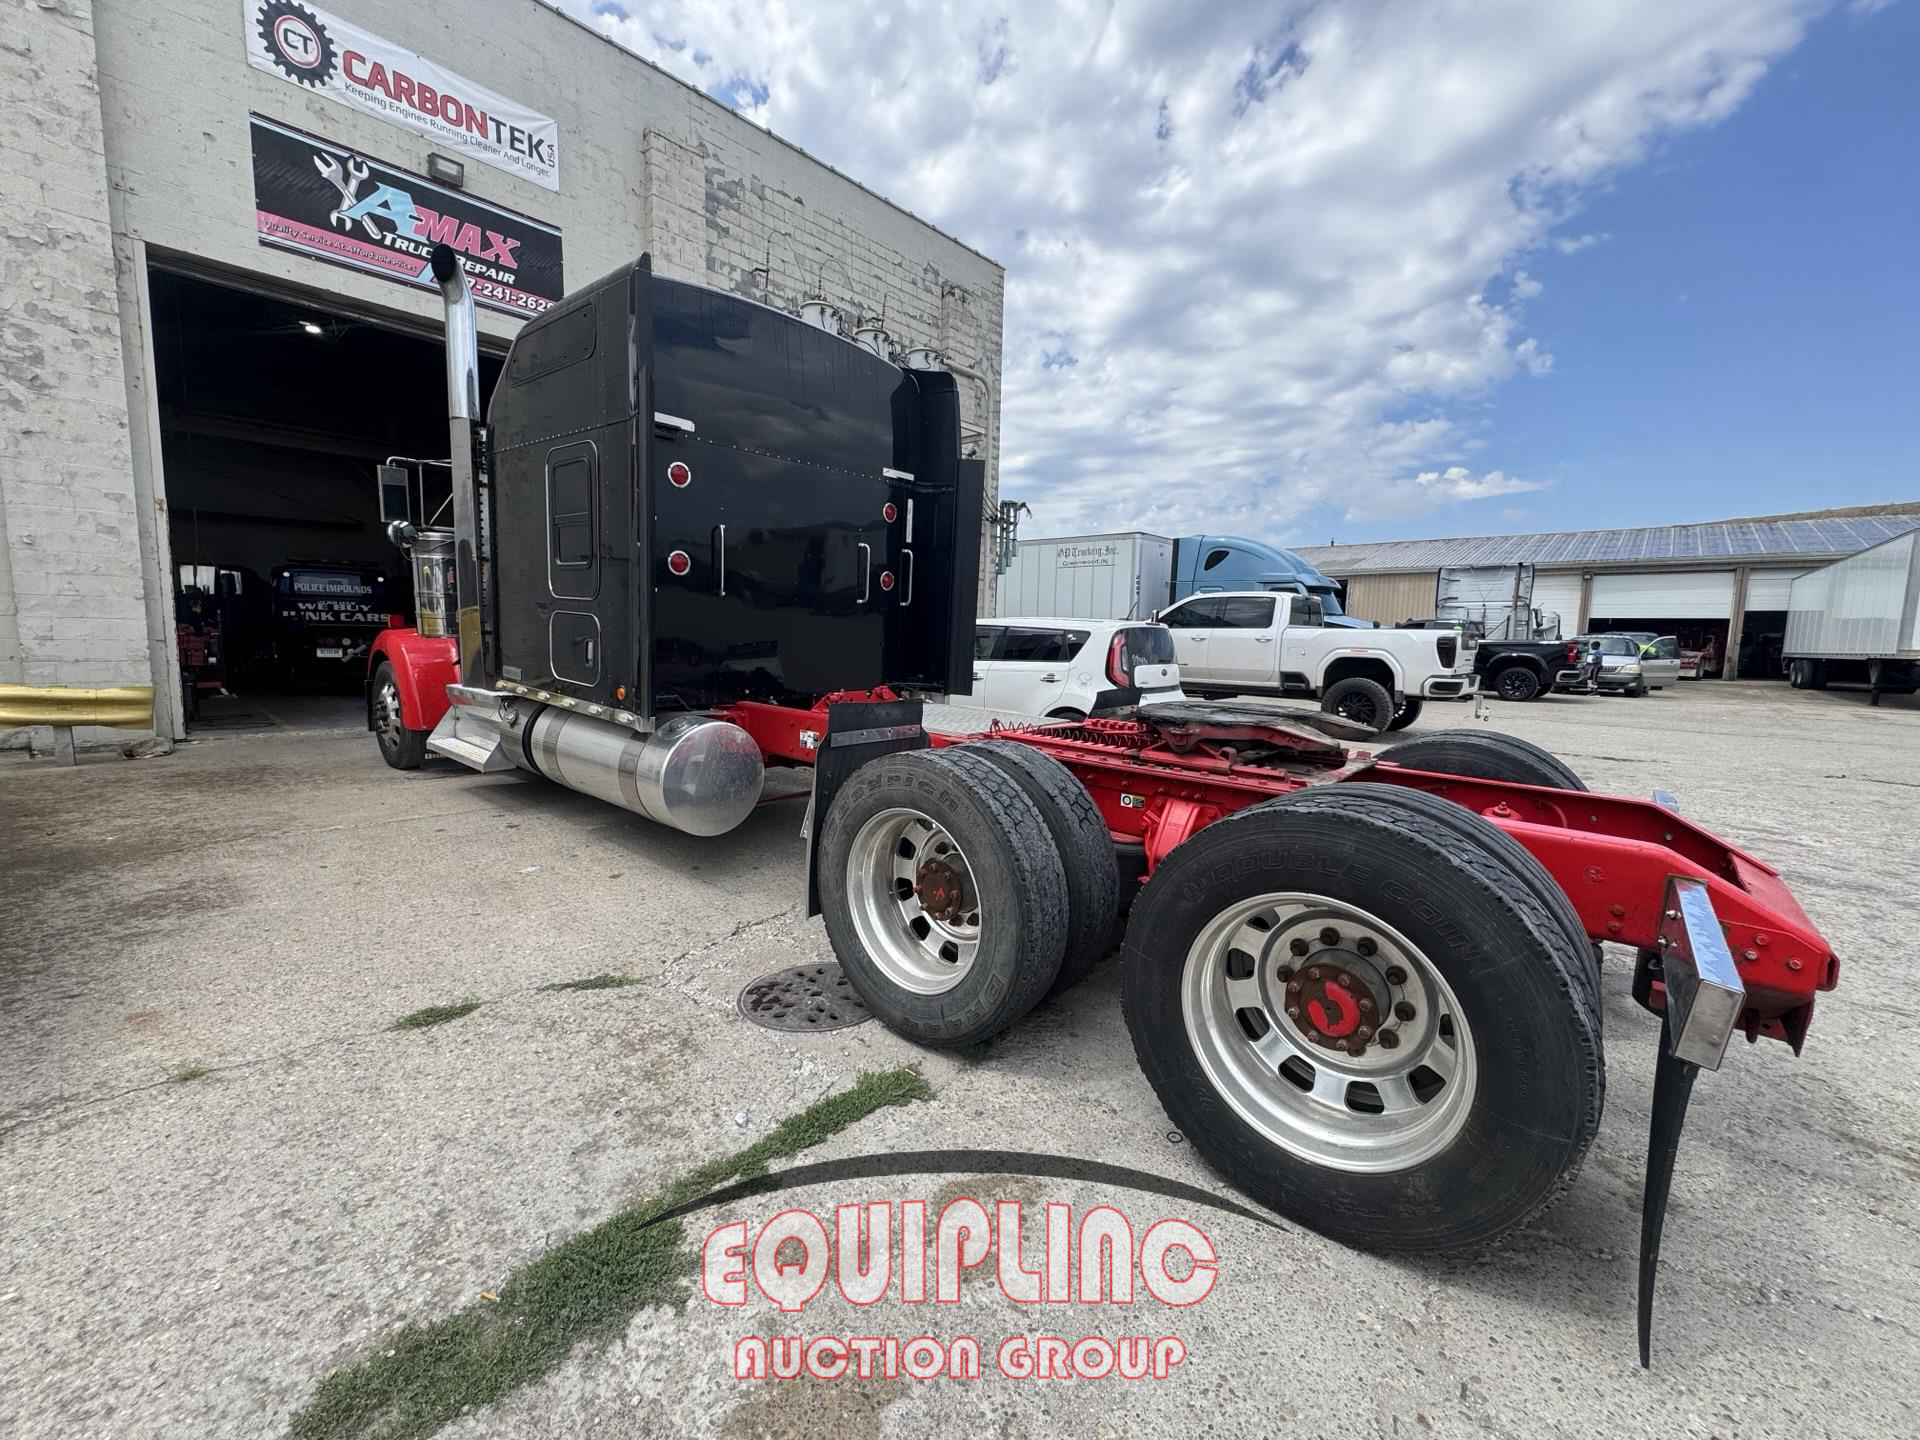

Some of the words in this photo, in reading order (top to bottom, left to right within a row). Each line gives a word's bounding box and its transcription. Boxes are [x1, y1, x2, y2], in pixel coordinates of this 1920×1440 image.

[283, 27, 313, 55] CT
[343, 50, 546, 164] CARBONTEK
[345, 82, 387, 110] Keeping
[389, 101, 429, 127] Engines
[430, 120, 468, 145] Running
[470, 135, 501, 156] Cleaner
[503, 151, 520, 165] And
[547, 144, 556, 168] USA
[264, 219, 299, 238] Quality
[300, 231, 333, 247] Service
[334, 241, 345, 251] At
[345, 245, 392, 264] Affordable
[392, 259, 417, 272] Prices
[383, 231, 433, 258] TRUC
[456, 255, 516, 285] REPAIR
[294, 583, 325, 592] POLICE
[326, 583, 372, 594] IMPOUNDS
[298, 602, 329, 610] WE
[333, 603, 371, 611] BUY
[1210, 850, 1374, 883] DOUBLE
[1379, 879, 1484, 961] COIN
